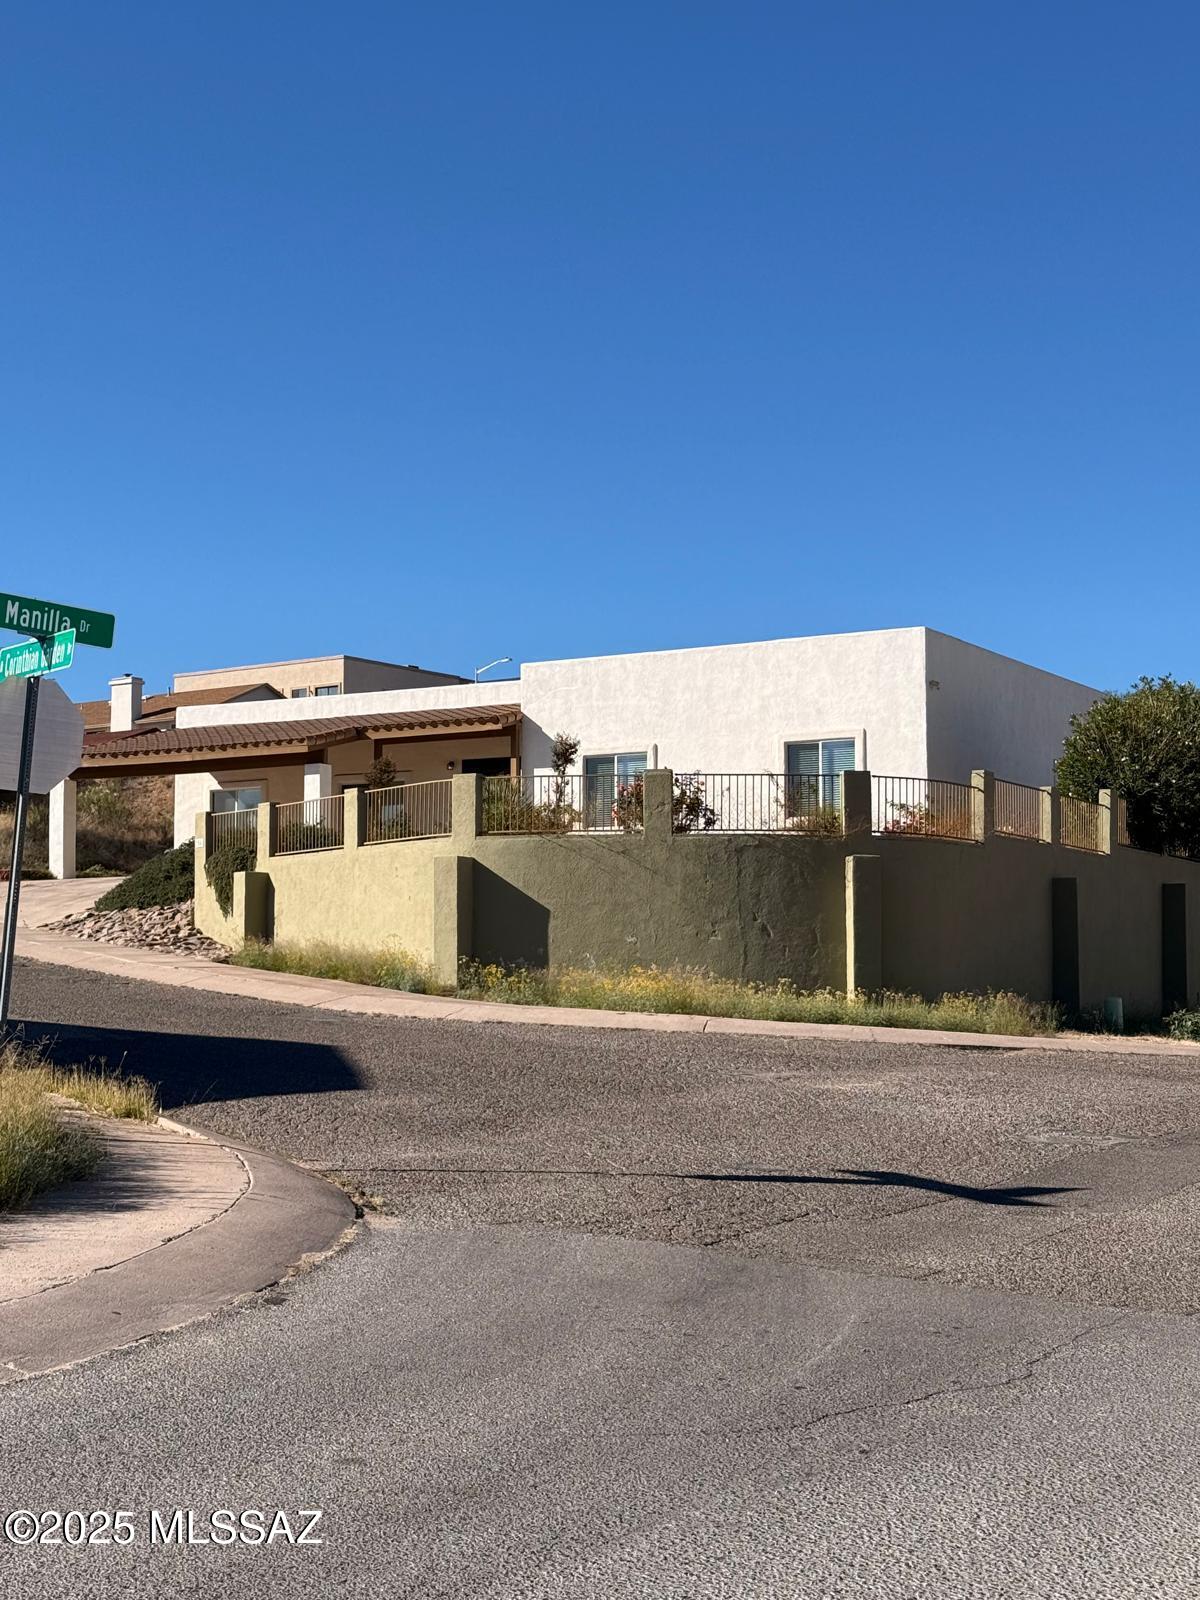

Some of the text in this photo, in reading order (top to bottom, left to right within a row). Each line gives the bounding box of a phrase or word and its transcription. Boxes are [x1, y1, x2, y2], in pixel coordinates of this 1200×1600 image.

[5, 600, 91, 632] Manilla Dr
[5, 647, 39, 677] Corinthian
